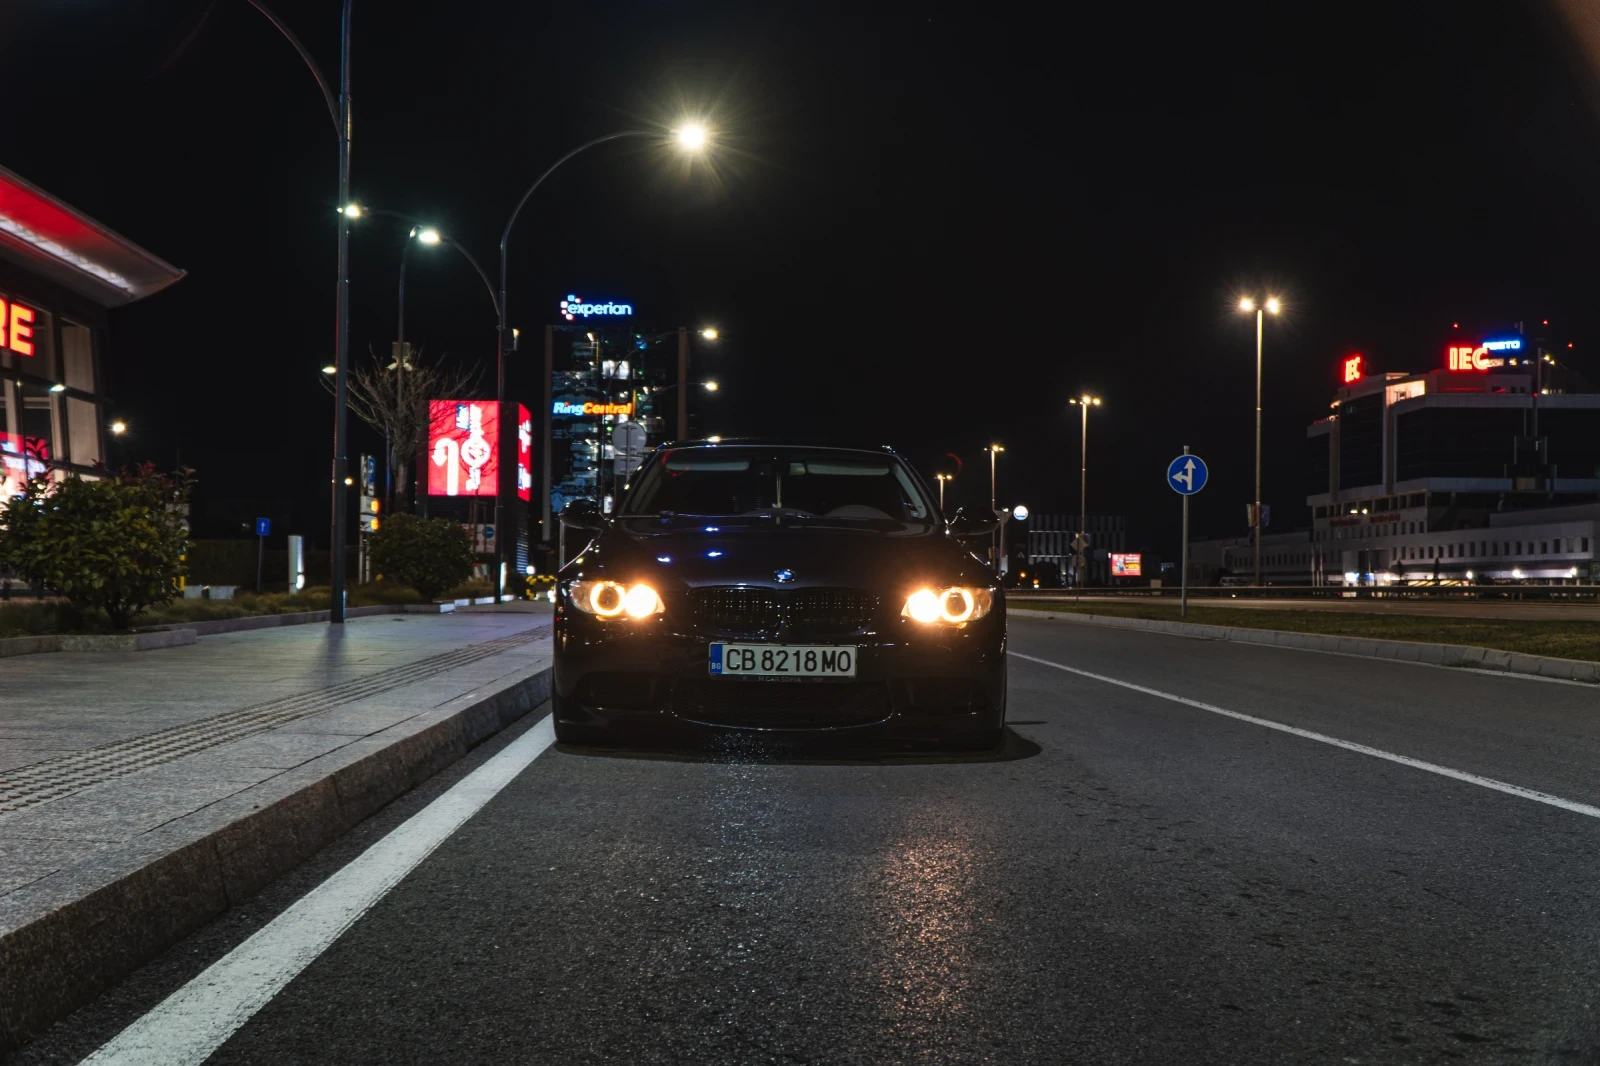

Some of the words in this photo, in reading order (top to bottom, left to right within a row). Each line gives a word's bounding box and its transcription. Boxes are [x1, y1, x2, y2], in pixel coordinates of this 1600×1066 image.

[567, 301, 632, 317] experian
[1449, 347, 1488, 370] IEC
[553, 401, 633, 416] RingCentral
[726, 648, 756, 671] CB
[761, 649, 817, 673] 8218
[821, 650, 852, 673] MO
